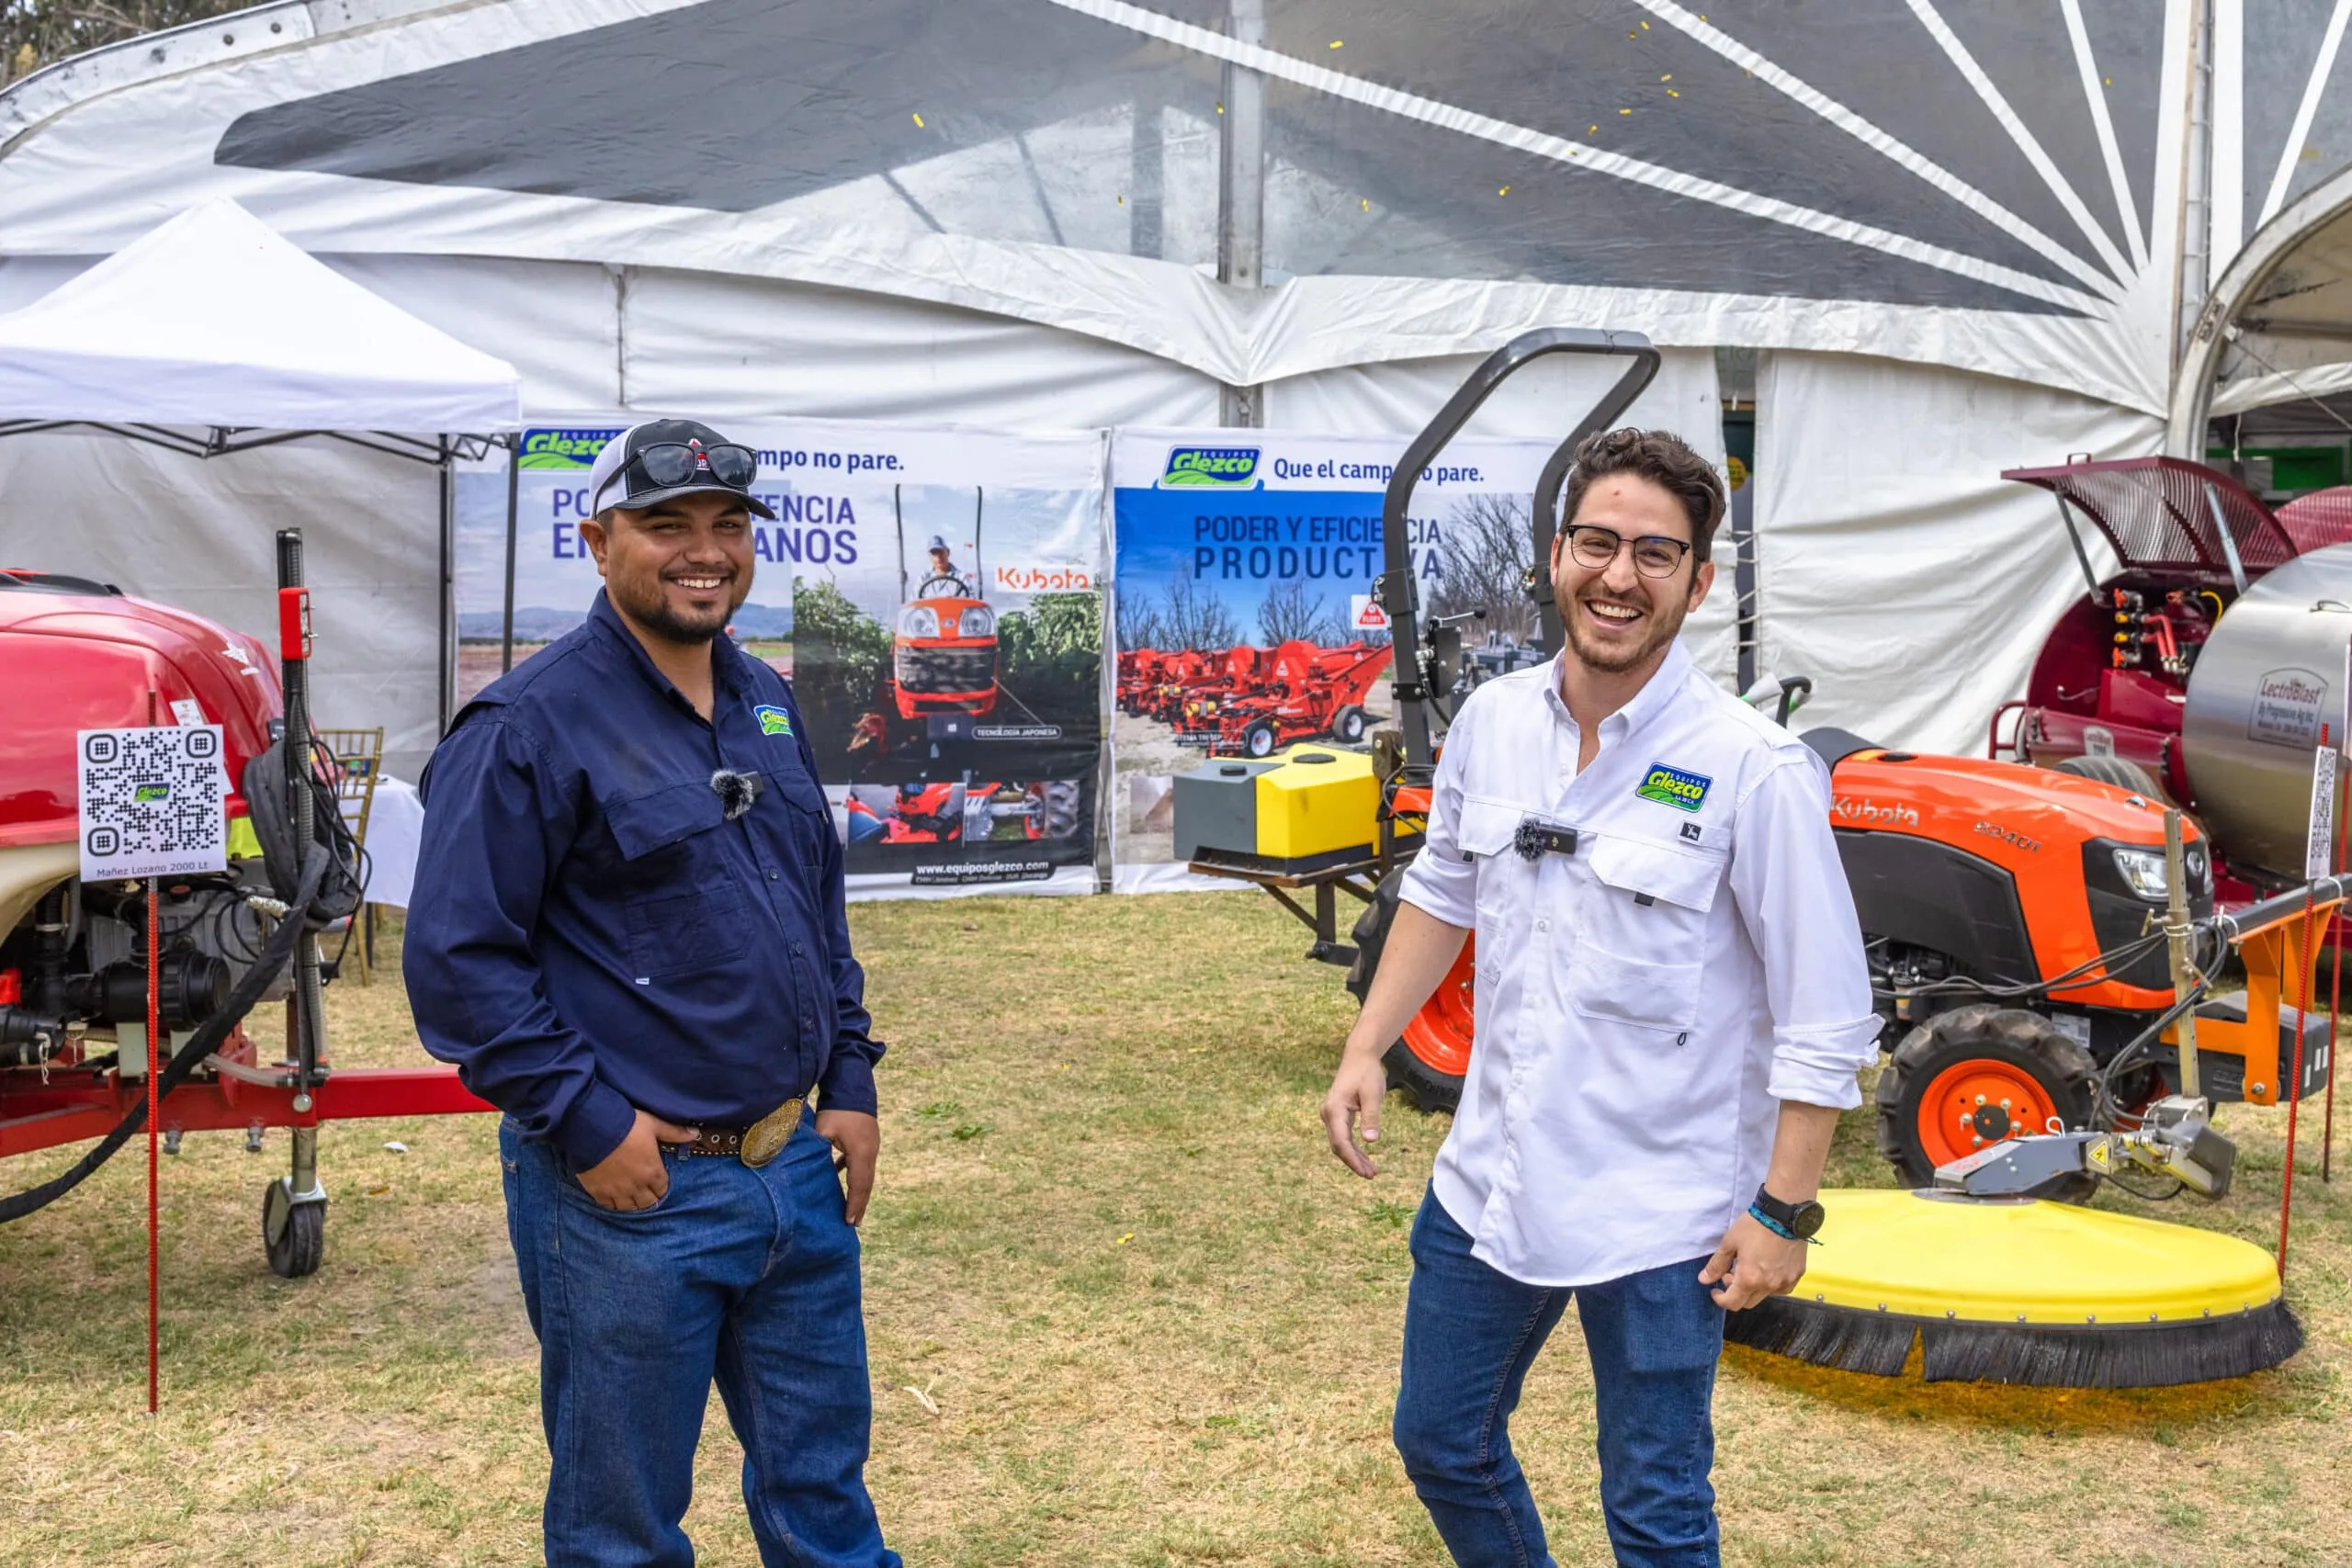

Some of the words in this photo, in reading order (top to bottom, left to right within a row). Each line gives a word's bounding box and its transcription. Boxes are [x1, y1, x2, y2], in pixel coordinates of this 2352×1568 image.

[526, 432, 606, 454] Glezc
[757, 449, 808, 471] mpo
[813, 452, 842, 468] no
[847, 453, 905, 474] pare.
[1173, 451, 1253, 473] Glezco
[1274, 457, 1313, 480] Que
[1317, 459, 1335, 478] el
[1340, 463, 1393, 484] camp
[1437, 467, 1485, 486] pare.
[751, 494, 856, 525] TENCIA
[1194, 515, 1280, 542] PODER
[1285, 515, 1304, 542] Y
[1309, 516, 1442, 544] EFICIECIA
[754, 526, 857, 565] ANOS
[998, 567, 1089, 590] Kubota
[1647, 771, 1703, 800] Glezco
[1830, 795, 1919, 827] Kubota
[96, 868, 129, 877] Mañez
[131, 865, 167, 874] Lozano
[170, 863, 196, 872] 2000
[198, 862, 209, 870] Lt
[916, 861, 1049, 875] www.equiposglezco.com
